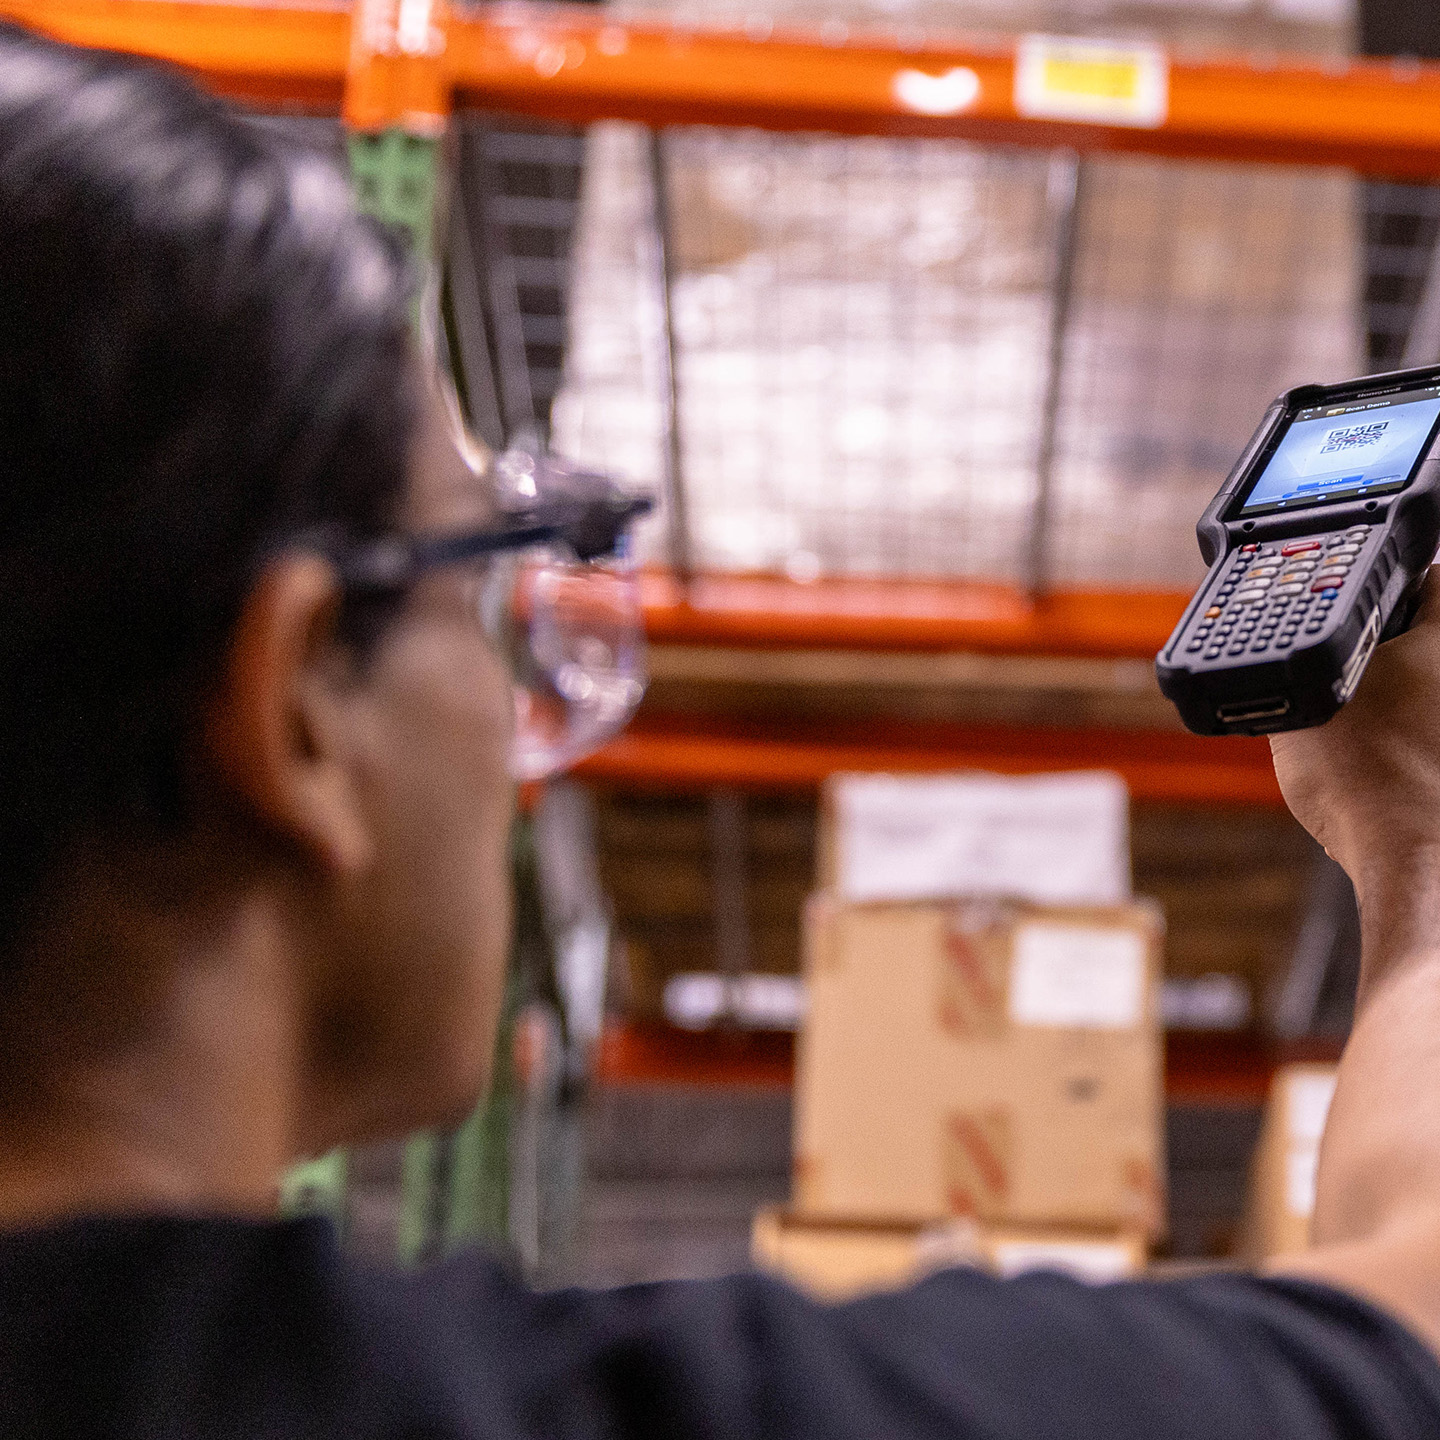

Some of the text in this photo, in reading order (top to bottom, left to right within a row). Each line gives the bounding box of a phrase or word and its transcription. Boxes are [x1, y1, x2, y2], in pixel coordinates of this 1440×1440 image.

[1357, 387, 1401, 398] Honeywell
[1367, 401, 1391, 409] Demo
[1318, 478, 1343, 486] Scan
